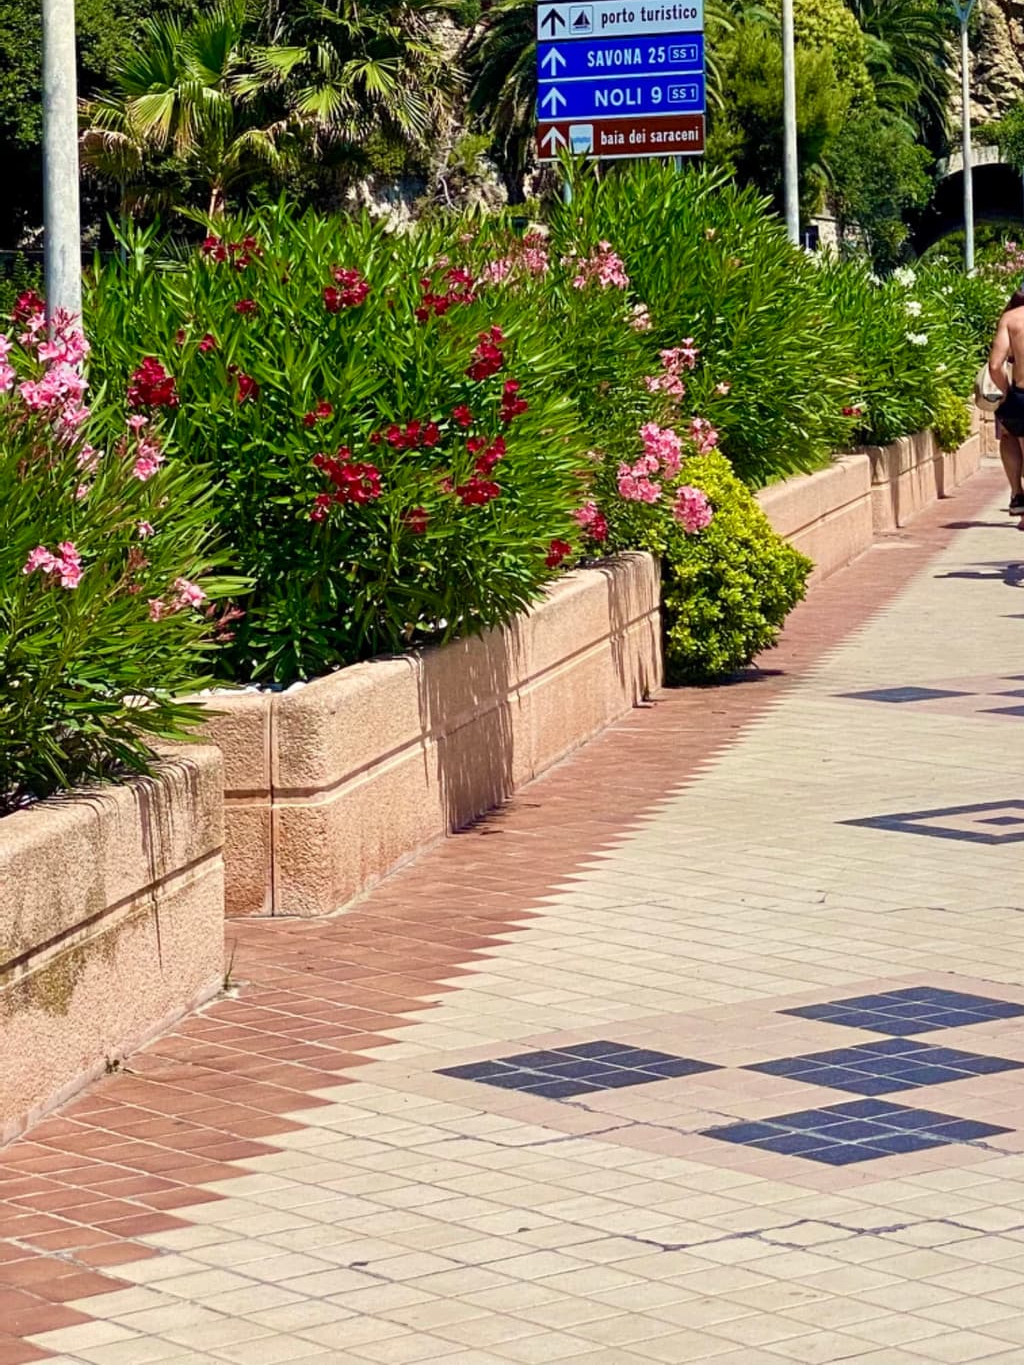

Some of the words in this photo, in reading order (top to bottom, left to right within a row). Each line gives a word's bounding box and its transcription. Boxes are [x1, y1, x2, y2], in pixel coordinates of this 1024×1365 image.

[601, 6, 635, 28] porto
[641, 3, 698, 22] turistico
[587, 48, 642, 67] SAVONA
[648, 46, 666, 64] 25
[672, 49, 687, 59] SS
[690, 48, 695, 58] 1
[595, 88, 642, 107] NOLI
[651, 86, 662, 104] 9
[672, 88, 687, 99] SS
[690, 87, 695, 98] 1
[600, 130, 625, 145] baia
[629, 128, 646, 144] dei
[650, 126, 699, 142] saraceni
